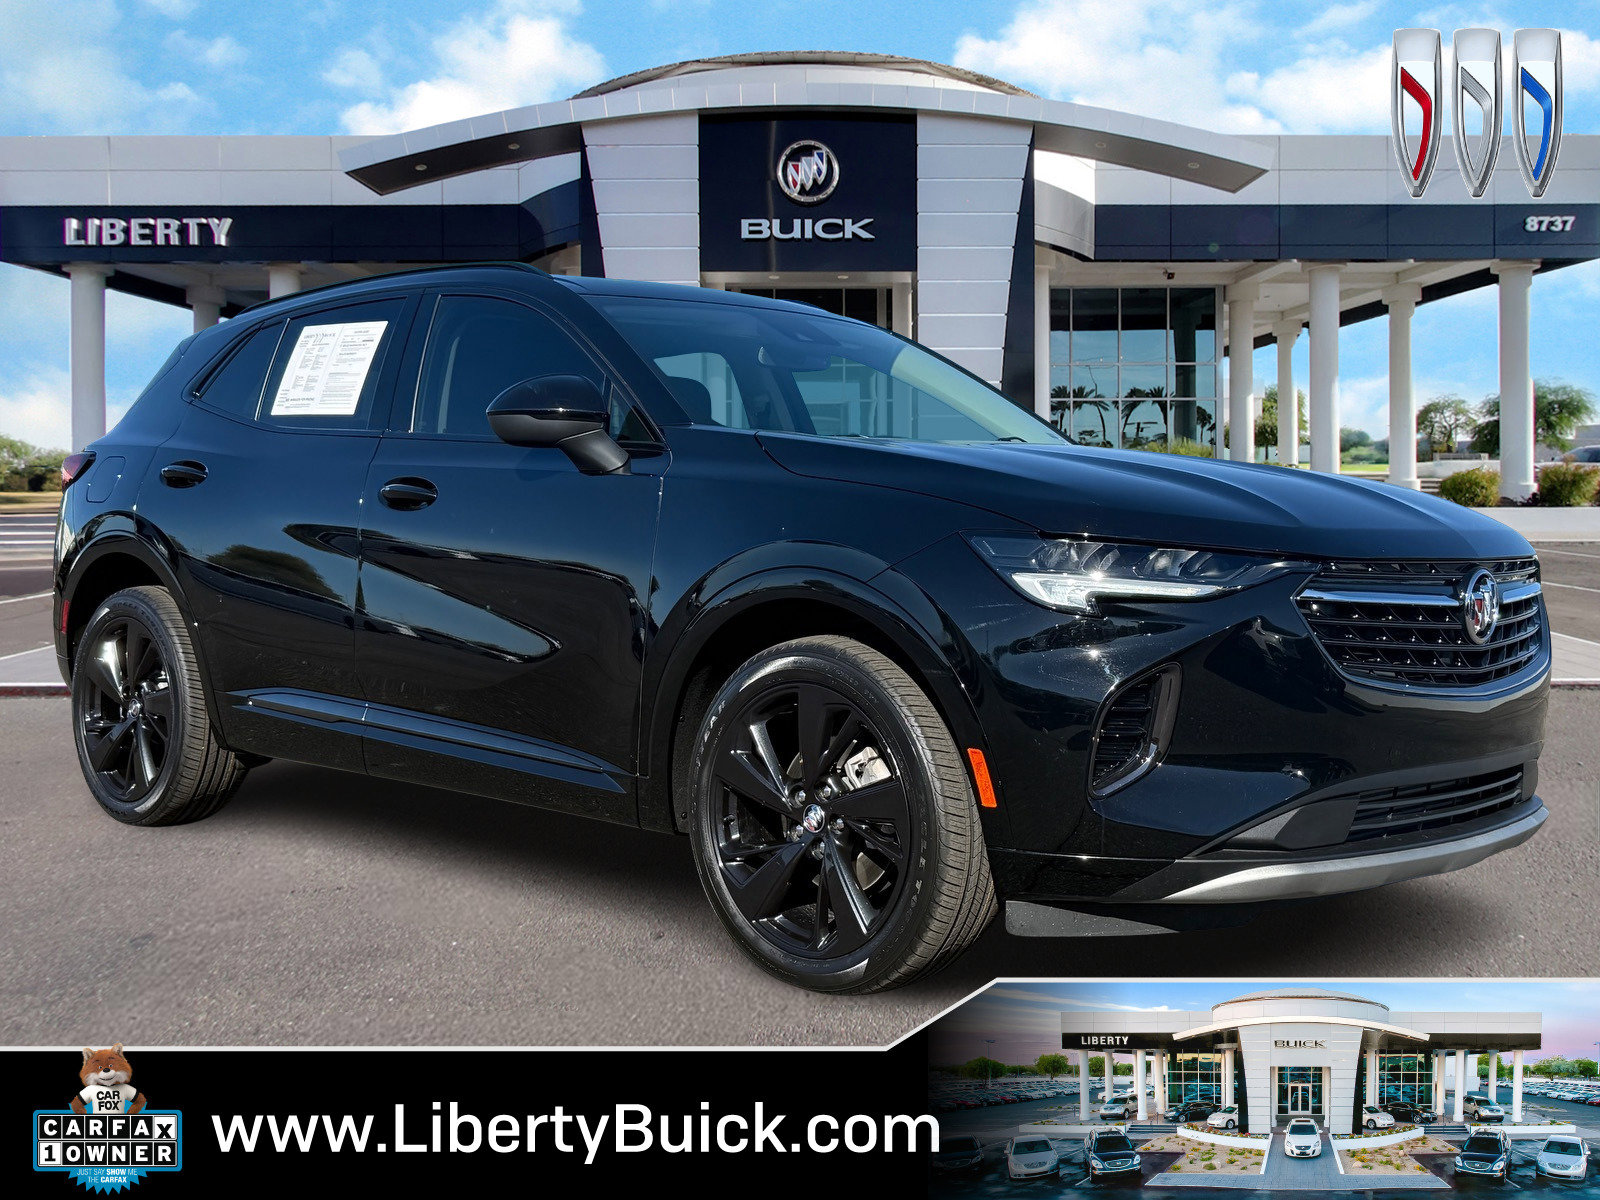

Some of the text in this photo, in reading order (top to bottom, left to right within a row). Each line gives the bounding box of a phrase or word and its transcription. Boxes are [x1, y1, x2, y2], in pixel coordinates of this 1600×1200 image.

[64, 217, 233, 246] LIBERTY
[741, 218, 875, 239] BUICK
[1524, 215, 1576, 232] 8737
[1081, 1035, 1129, 1046] LIBERTY
[1273, 1039, 1326, 1049] BUICK
